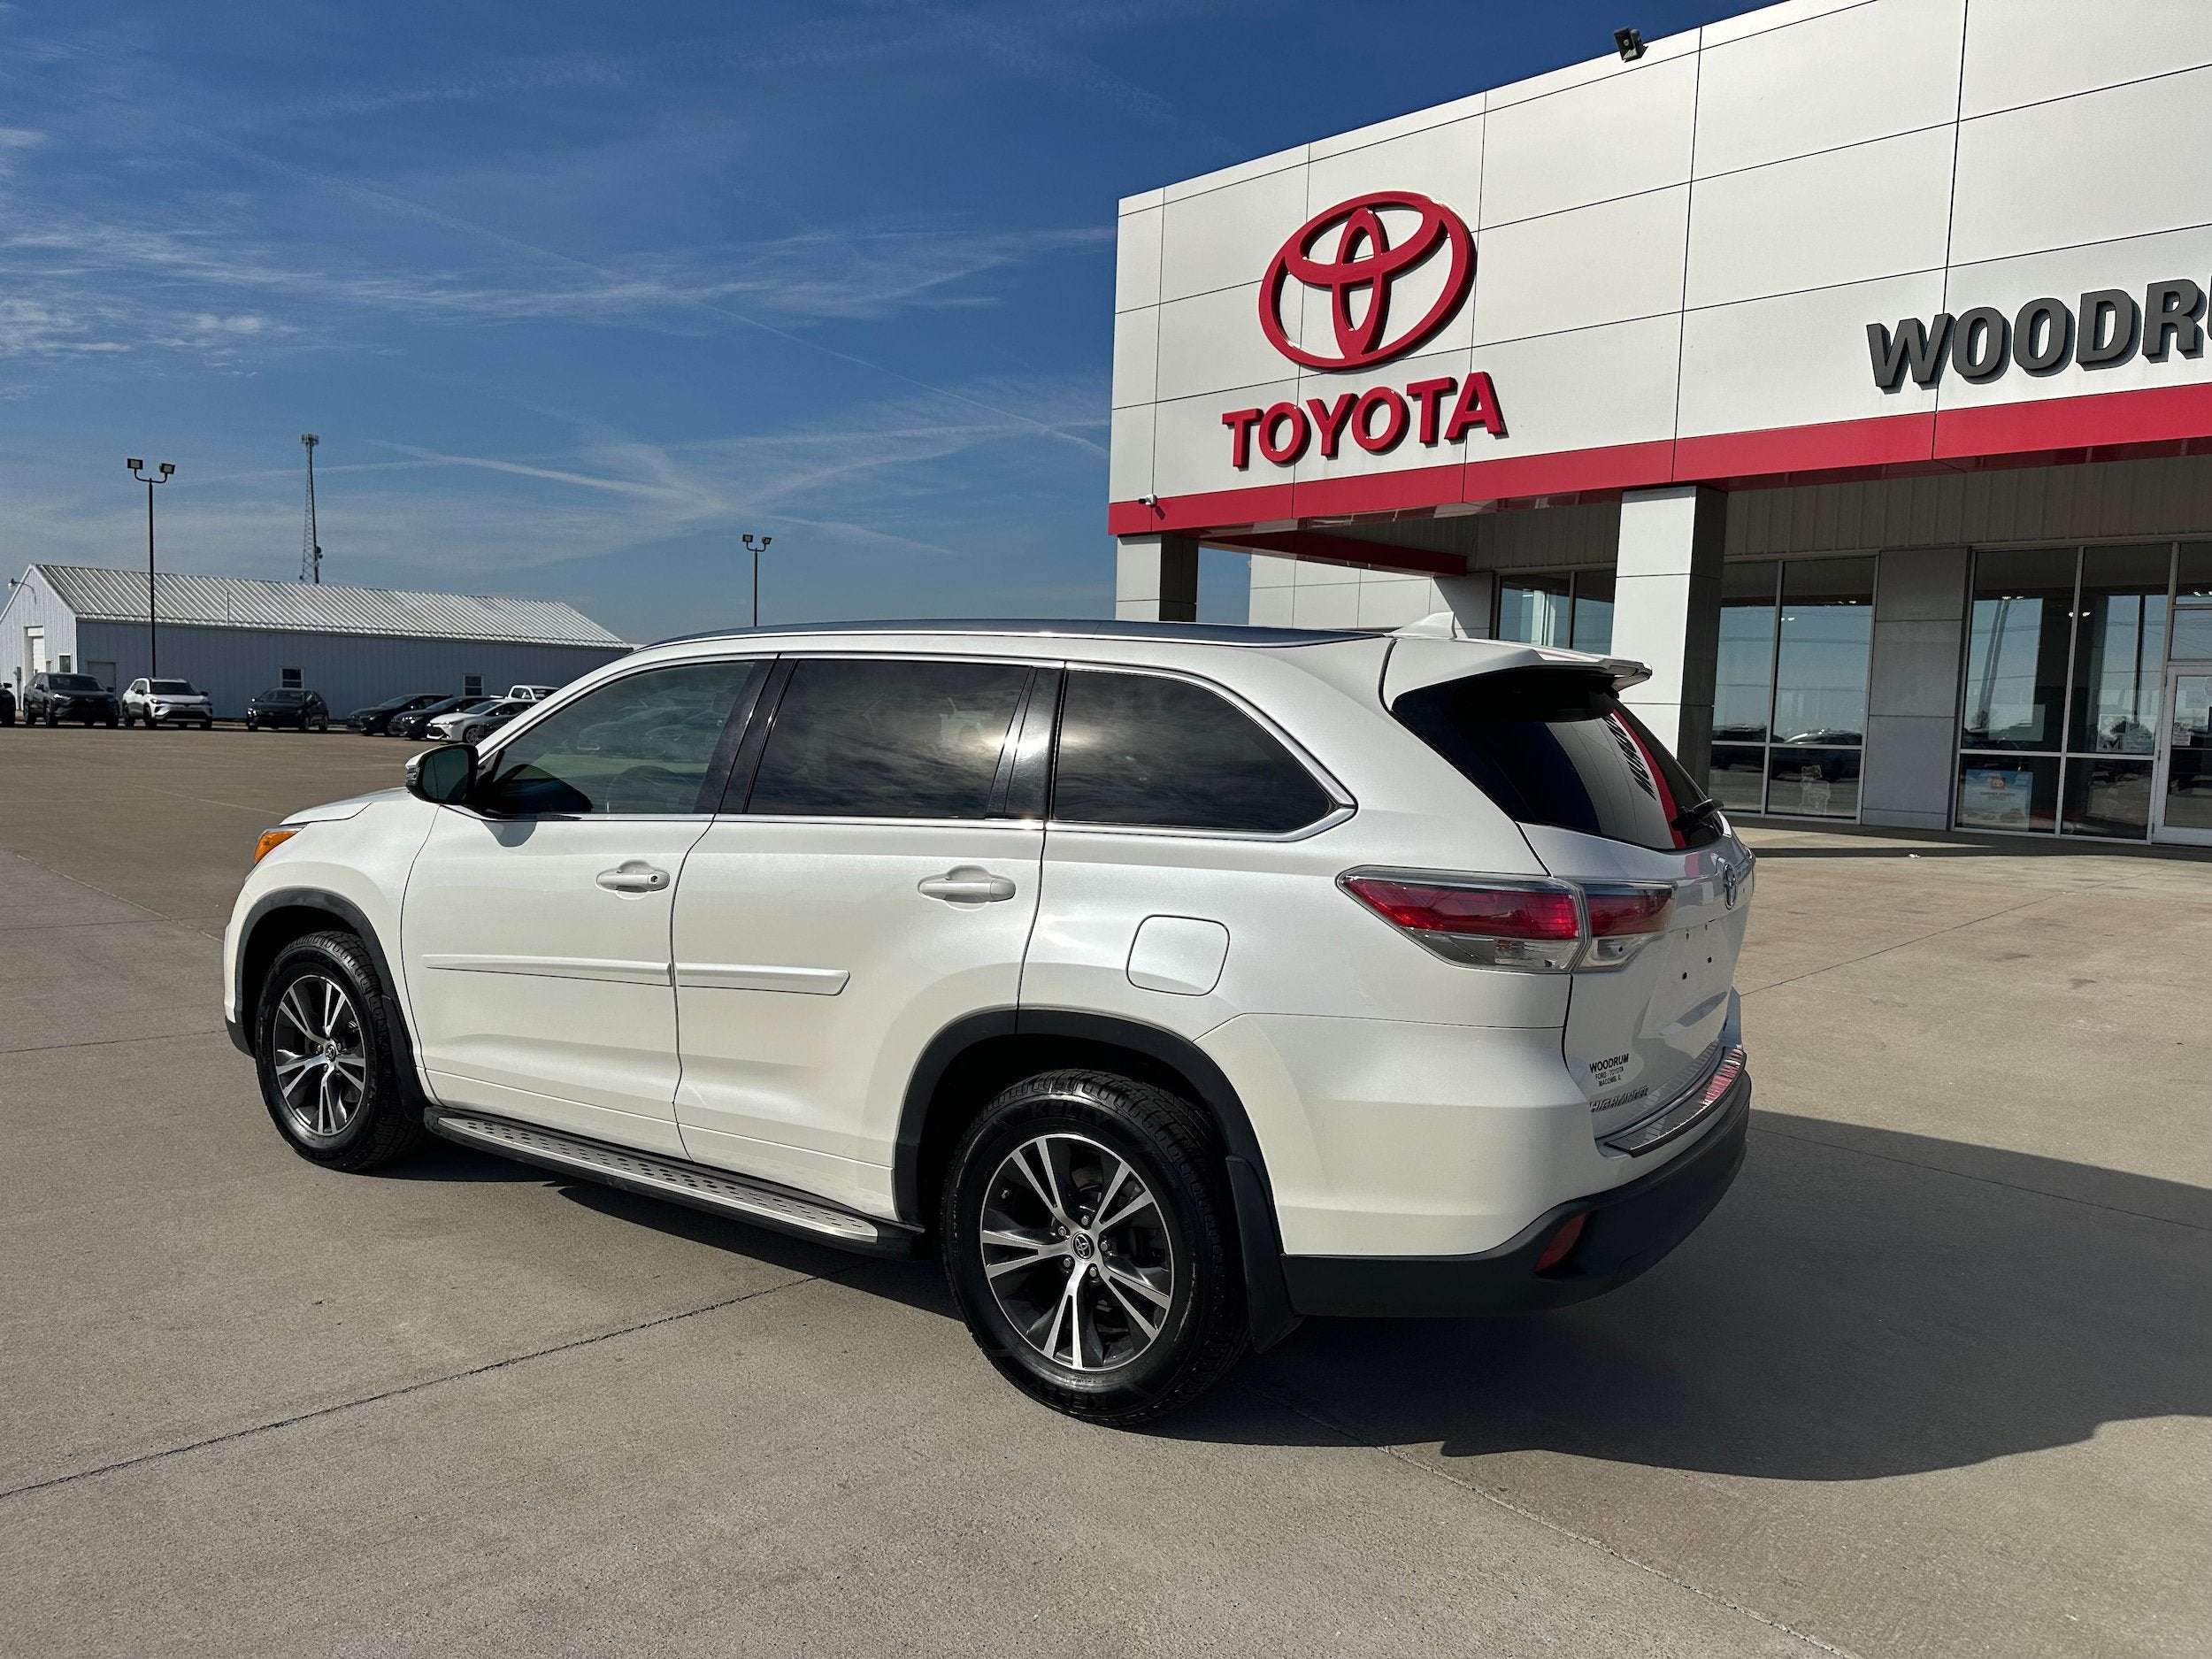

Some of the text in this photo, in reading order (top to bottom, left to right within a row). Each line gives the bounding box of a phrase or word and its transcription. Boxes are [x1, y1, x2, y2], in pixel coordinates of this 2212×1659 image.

[1866, 274, 2212, 395] WOODR
[1222, 371, 1508, 471] TOYOTA
[1589, 1053, 1630, 1073] WOODRUM
